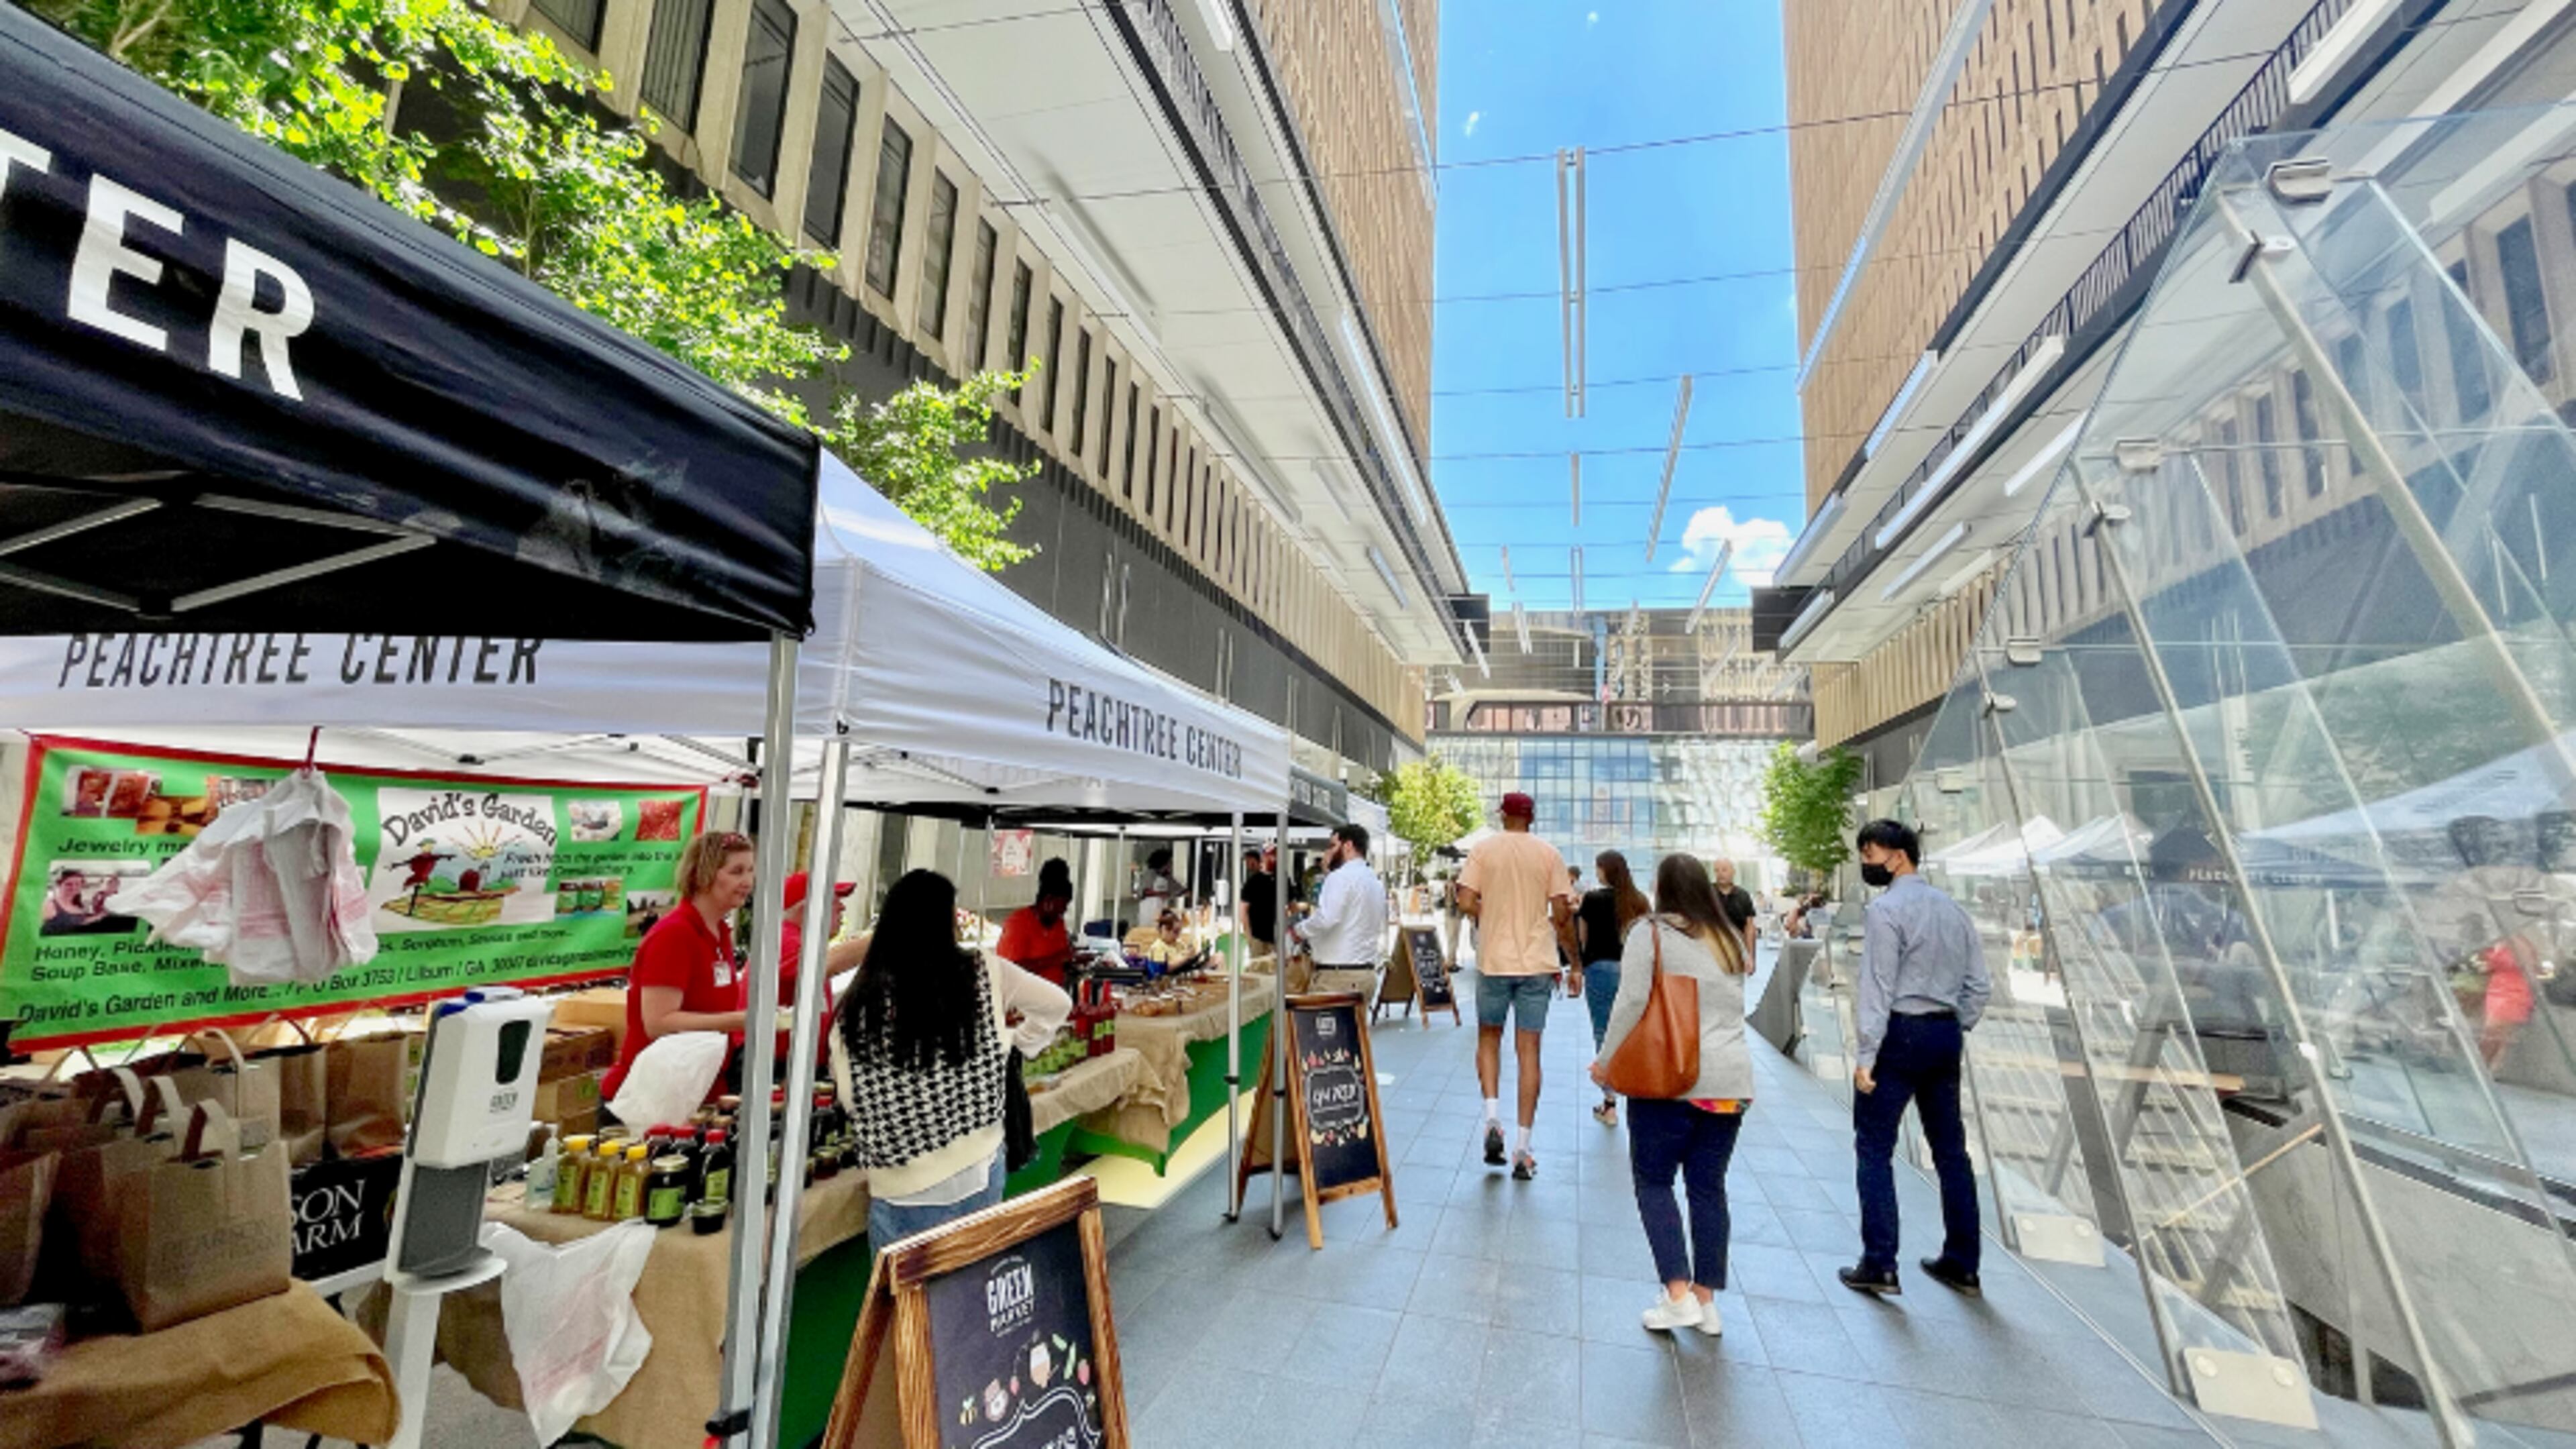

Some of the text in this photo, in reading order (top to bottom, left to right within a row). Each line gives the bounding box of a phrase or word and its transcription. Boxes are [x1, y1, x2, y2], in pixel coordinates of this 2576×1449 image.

[58, 632, 544, 688] PEACHTREE CENTER
[1047, 678, 1241, 780] PEACHTREE CENTER
[58, 837, 149, 855] Jewelry
[382, 792, 557, 847] David's Garden
[17, 1000, 99, 1024] David's
[105, 993, 175, 1015] Garden
[181, 987, 219, 1006] and
[329, 974, 358, 991] Box
[361, 967, 395, 987] 3753
[465, 959, 486, 976] GA
[32, 965, 85, 981] Soup
[987, 1263, 1034, 1316] GREEN
[990, 1297, 1034, 1332] MARKET
